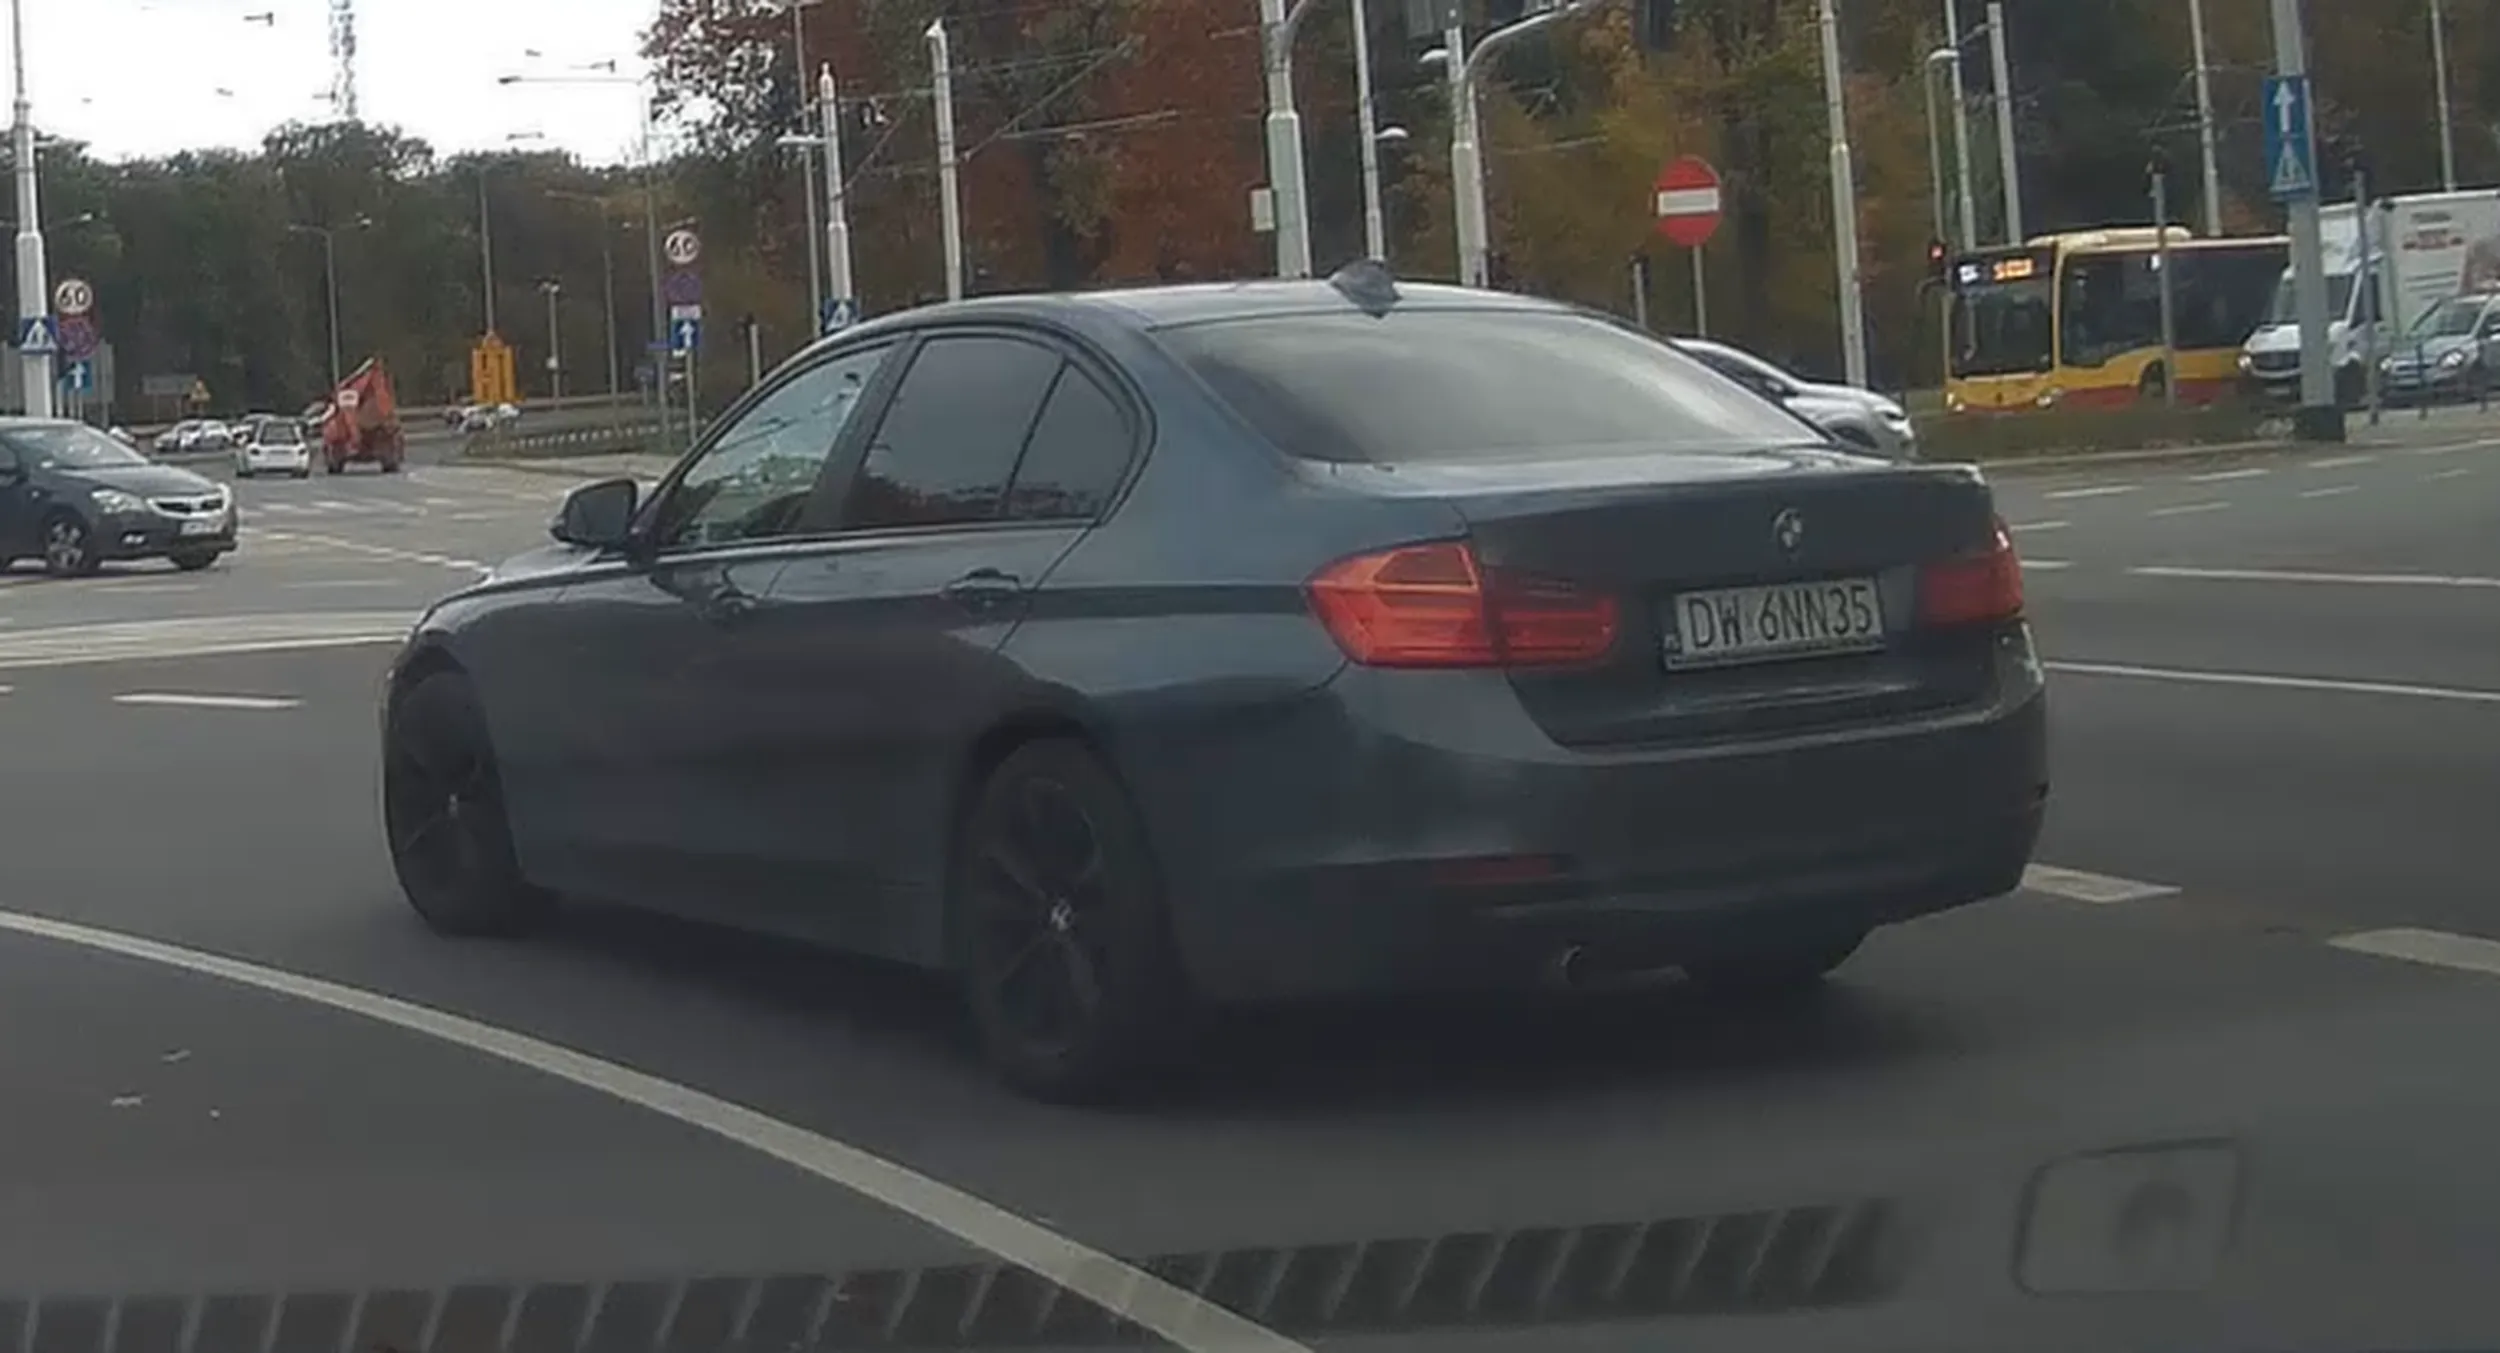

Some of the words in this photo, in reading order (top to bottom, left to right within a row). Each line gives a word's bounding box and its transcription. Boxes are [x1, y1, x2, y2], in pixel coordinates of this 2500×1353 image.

[670, 236, 697, 256] 60
[59, 285, 88, 307] 60
[1687, 596, 1742, 648] DW
[1758, 585, 1872, 642] 6NN35
